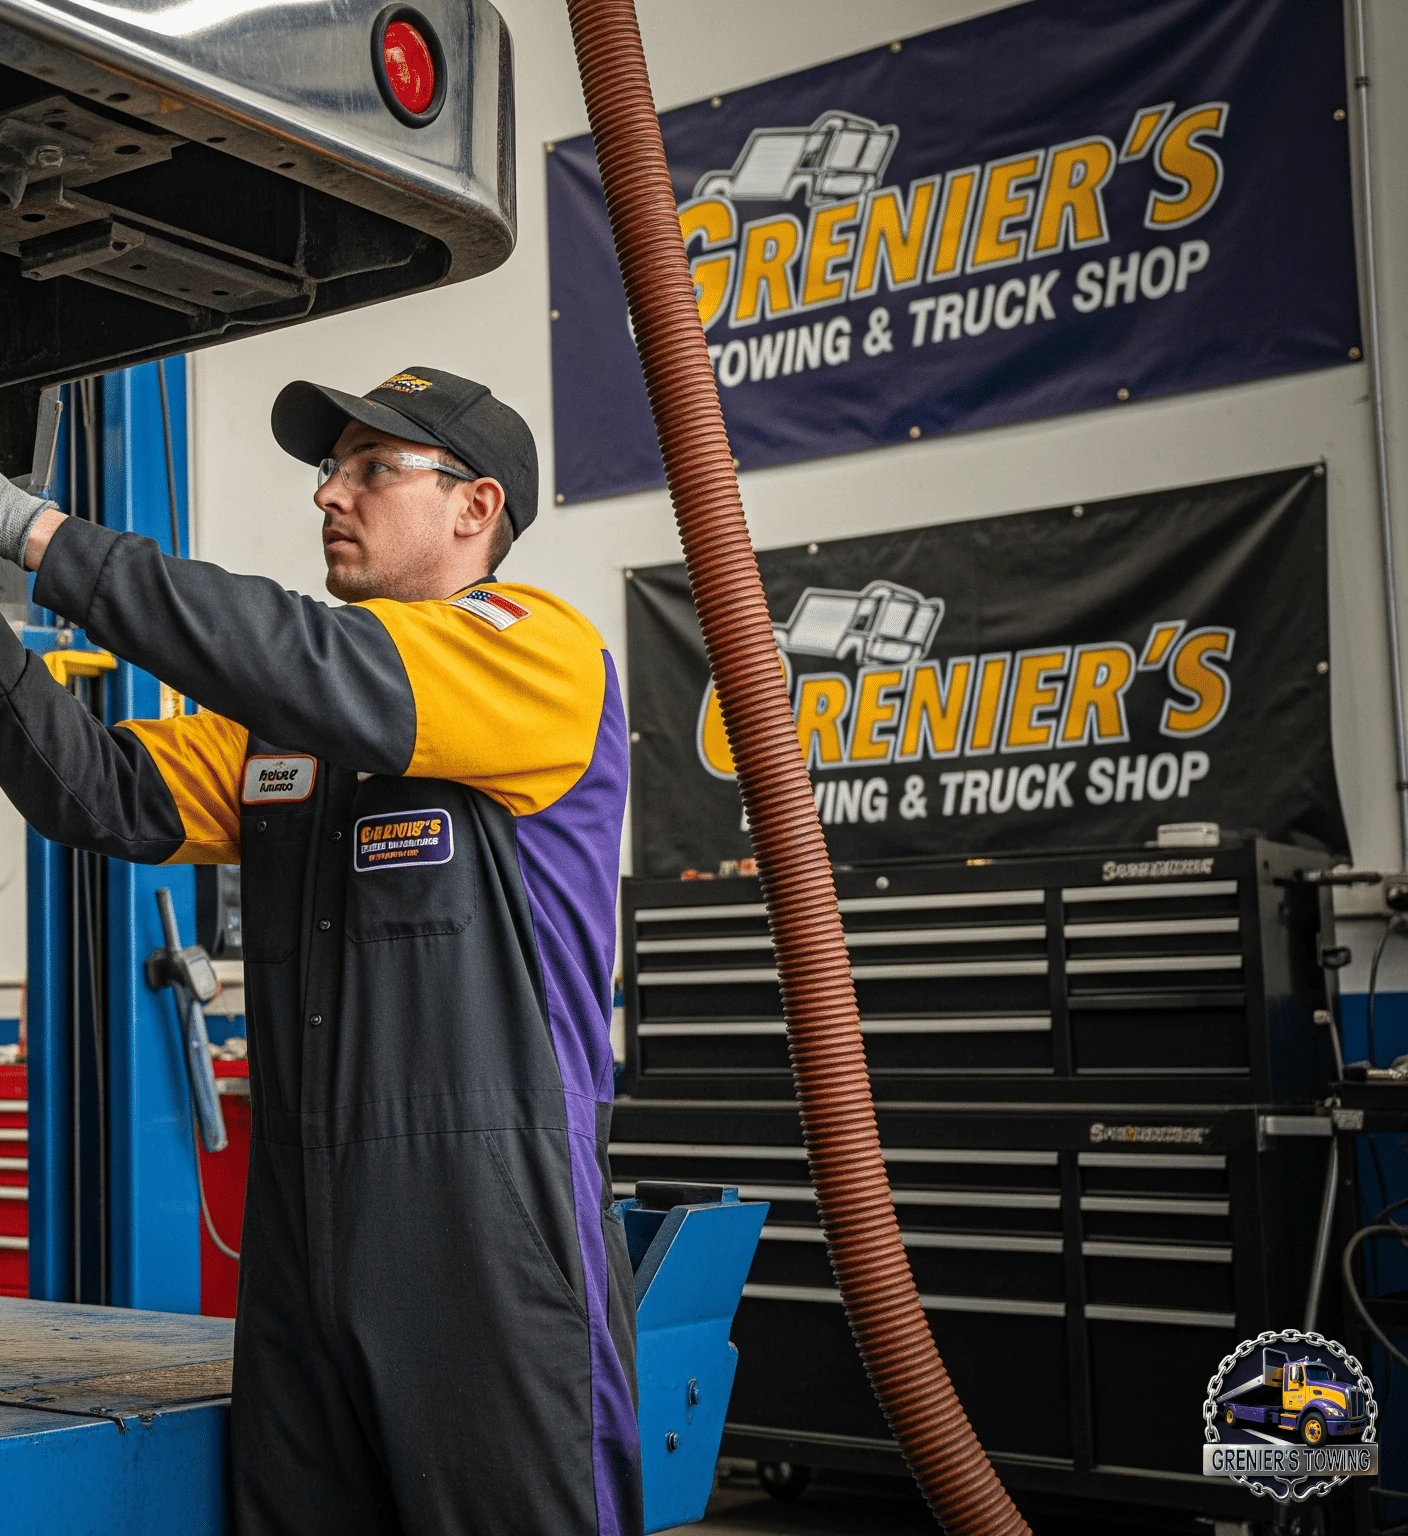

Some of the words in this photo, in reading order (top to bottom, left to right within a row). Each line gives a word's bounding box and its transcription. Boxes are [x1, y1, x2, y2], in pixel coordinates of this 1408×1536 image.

[862, 306, 894, 357] &
[908, 269, 1062, 348] TRUCK
[1072, 239, 1210, 314] SHOP
[899, 775, 928, 820] &
[939, 761, 1077, 817] TRUCK
[1085, 750, 1210, 805] SHOP
